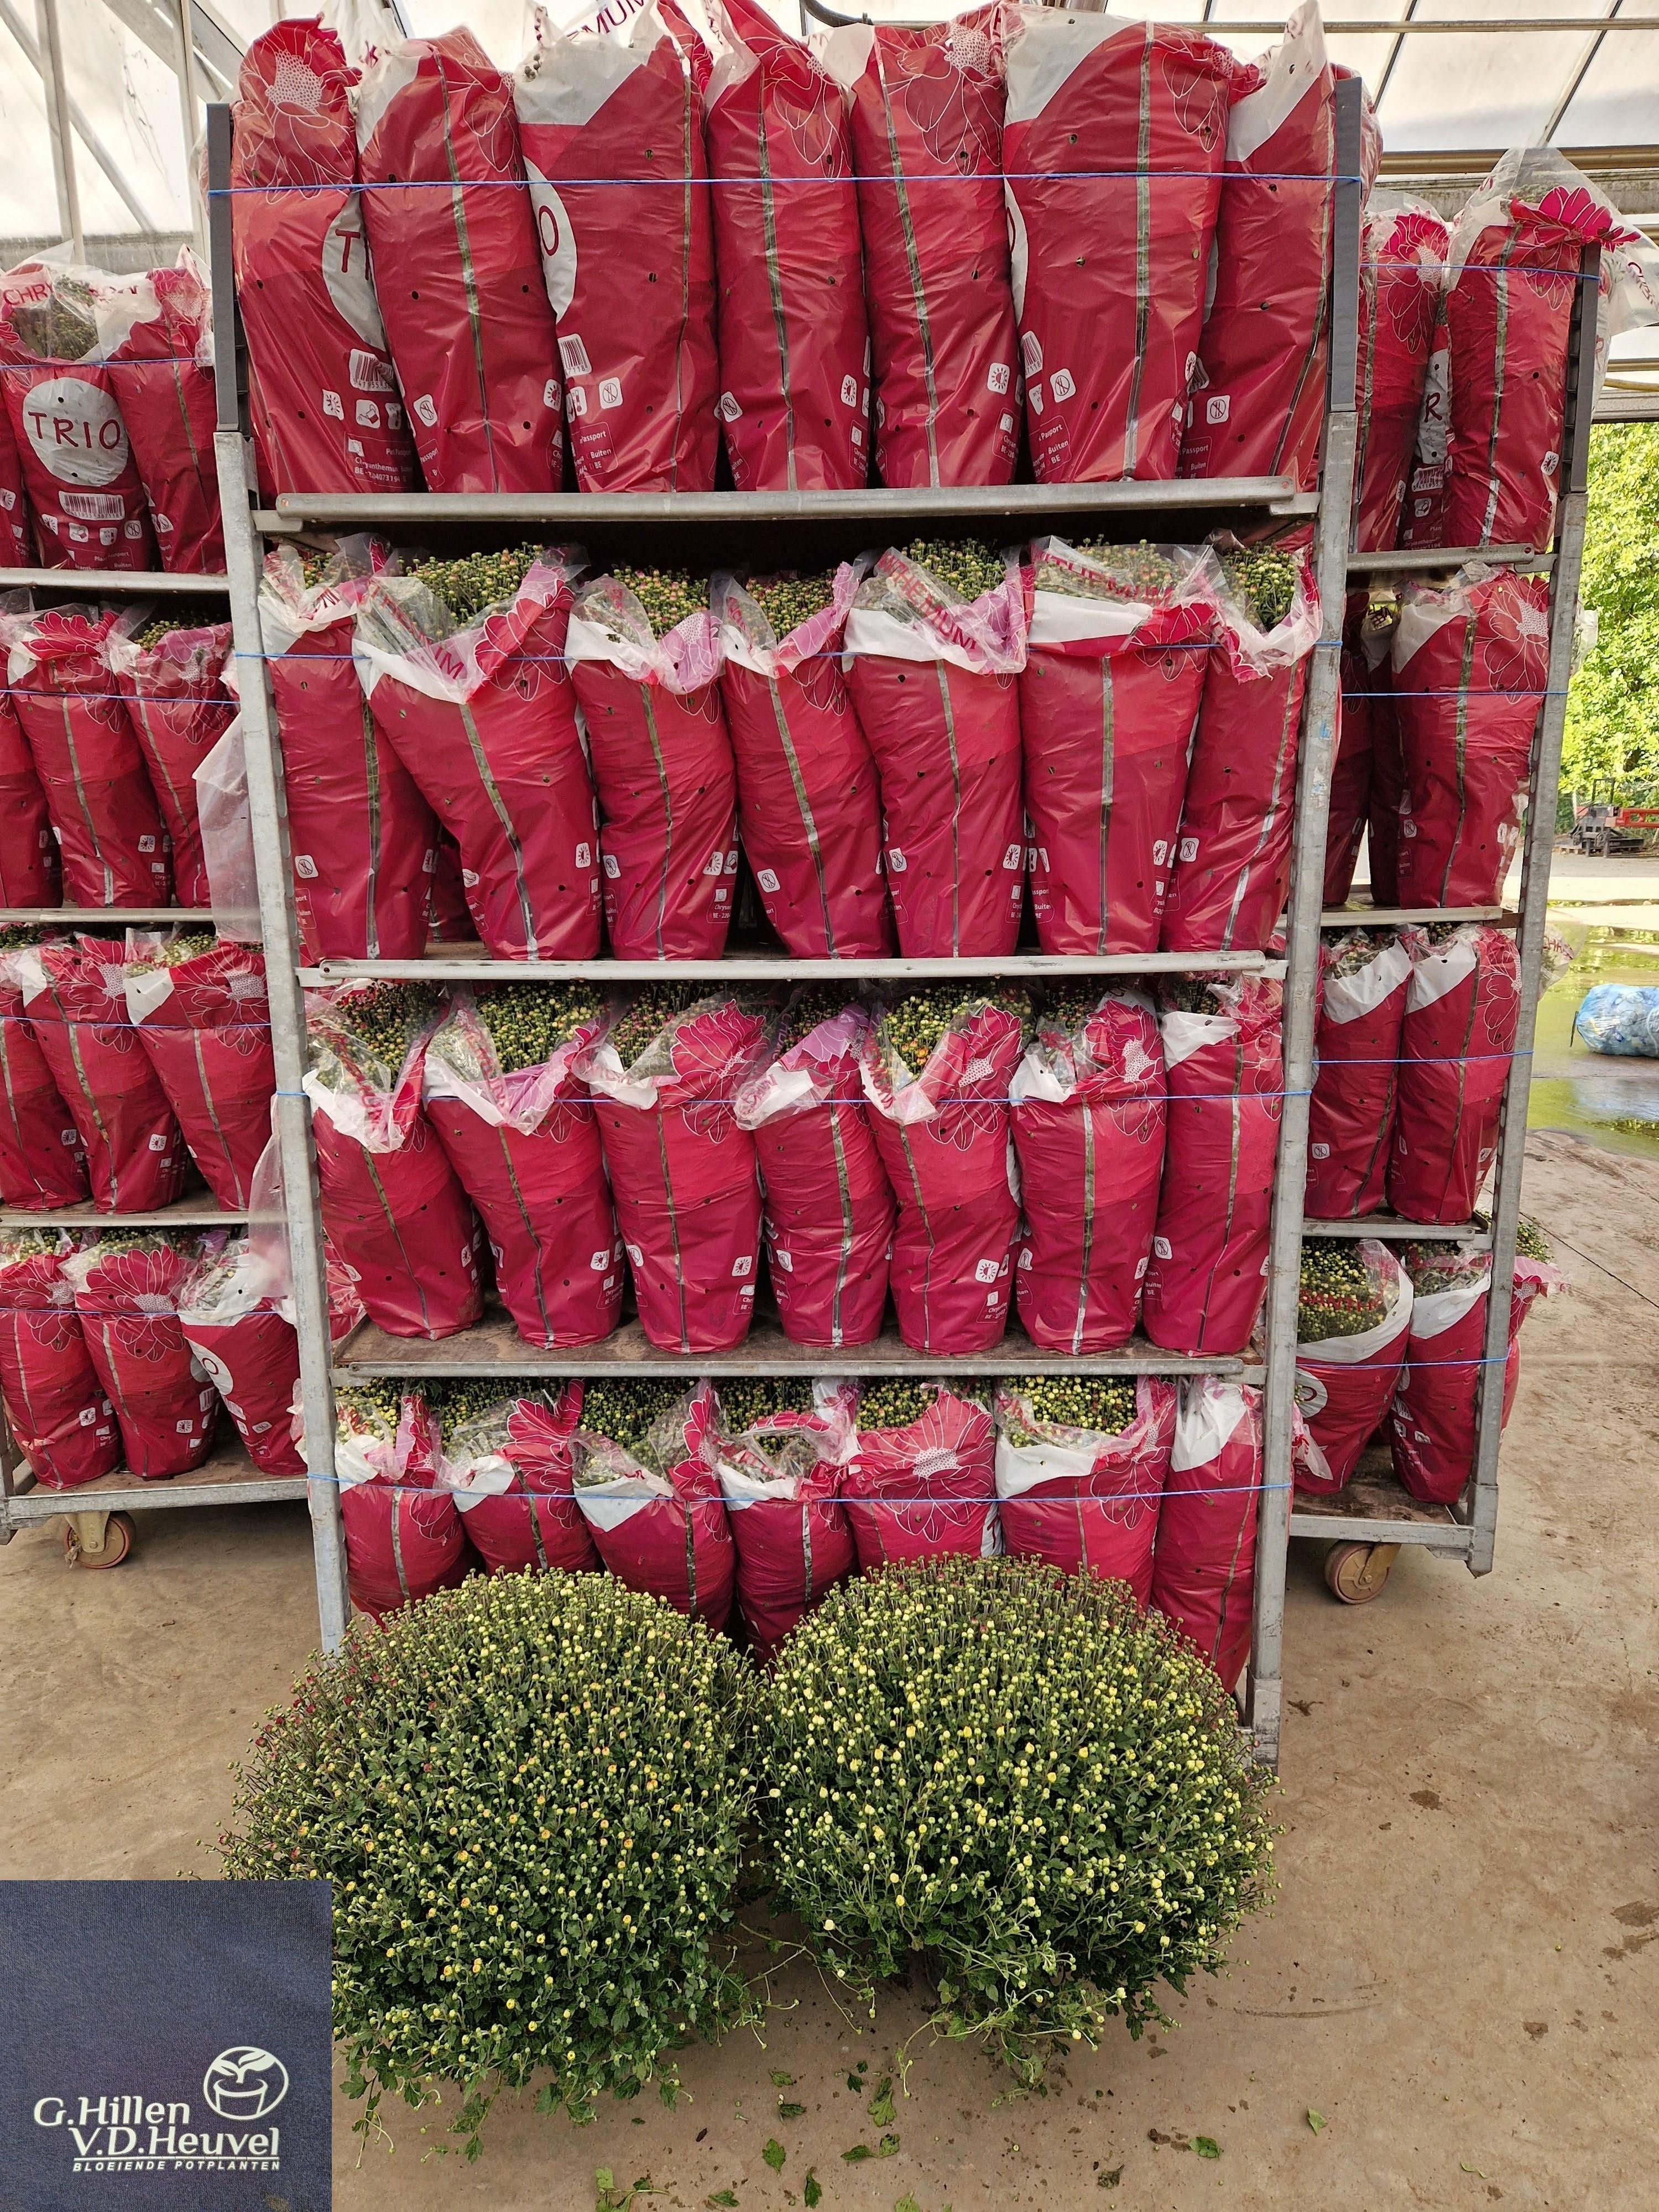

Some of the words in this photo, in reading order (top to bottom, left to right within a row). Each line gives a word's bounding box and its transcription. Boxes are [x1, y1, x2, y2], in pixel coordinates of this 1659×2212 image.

[1425, 393, 1443, 422] R
[28, 411, 121, 450] TRIO
[591, 448, 612, 458] Buiten
[1048, 440, 1070, 455] Buiten
[1051, 454, 1061, 464] BE
